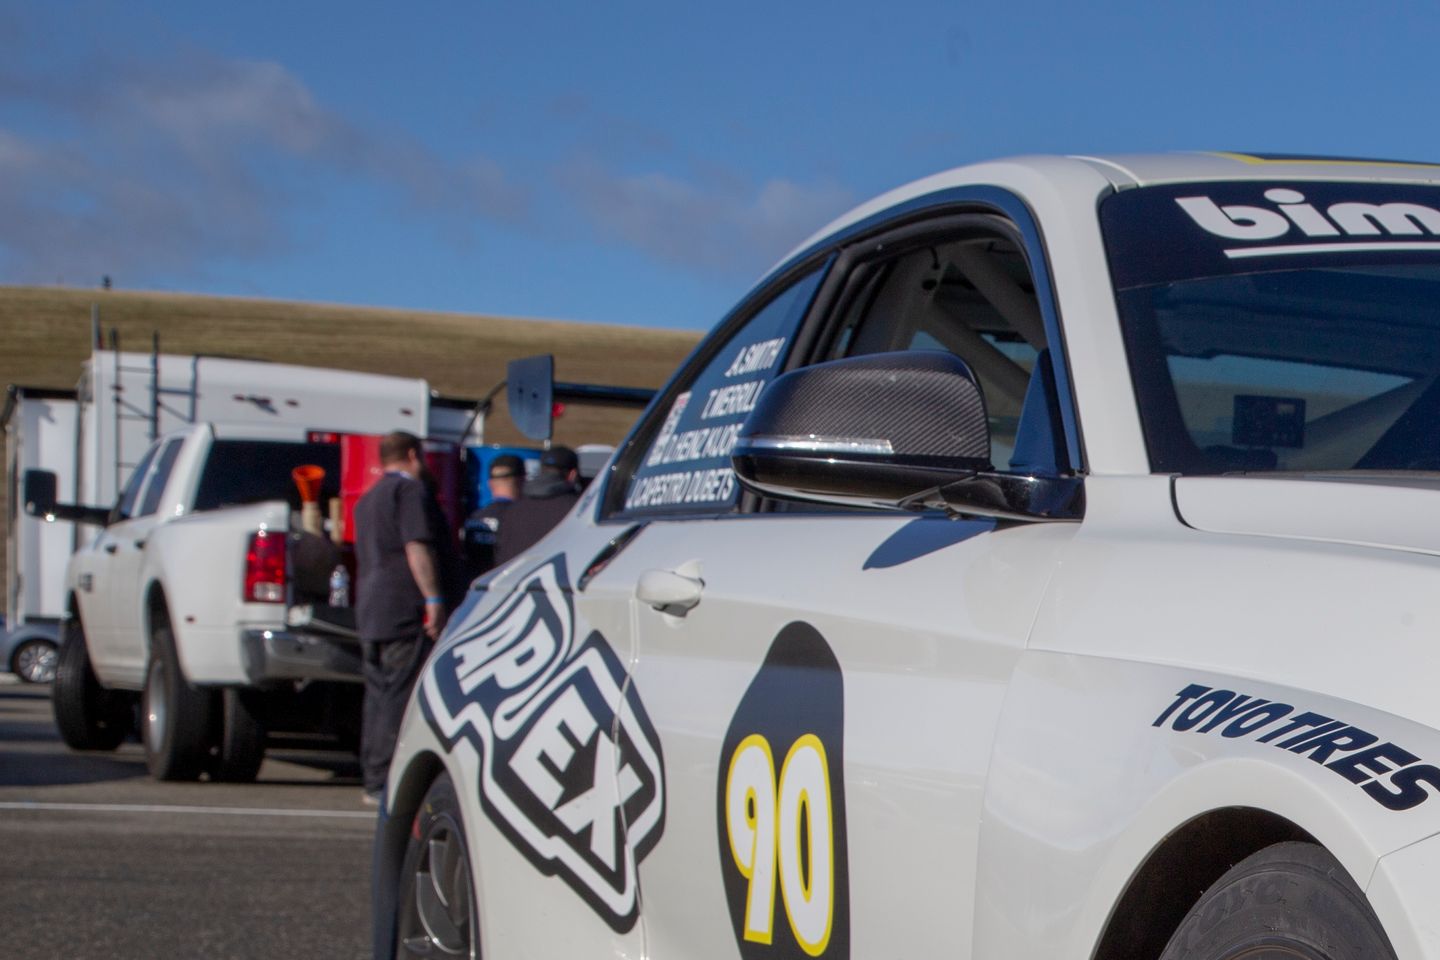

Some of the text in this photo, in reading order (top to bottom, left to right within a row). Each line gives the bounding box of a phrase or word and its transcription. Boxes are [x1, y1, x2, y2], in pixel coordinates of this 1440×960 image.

[452, 592, 644, 872] APEX
[1152, 683, 1295, 738] TOYO
[726, 733, 834, 957] 90
